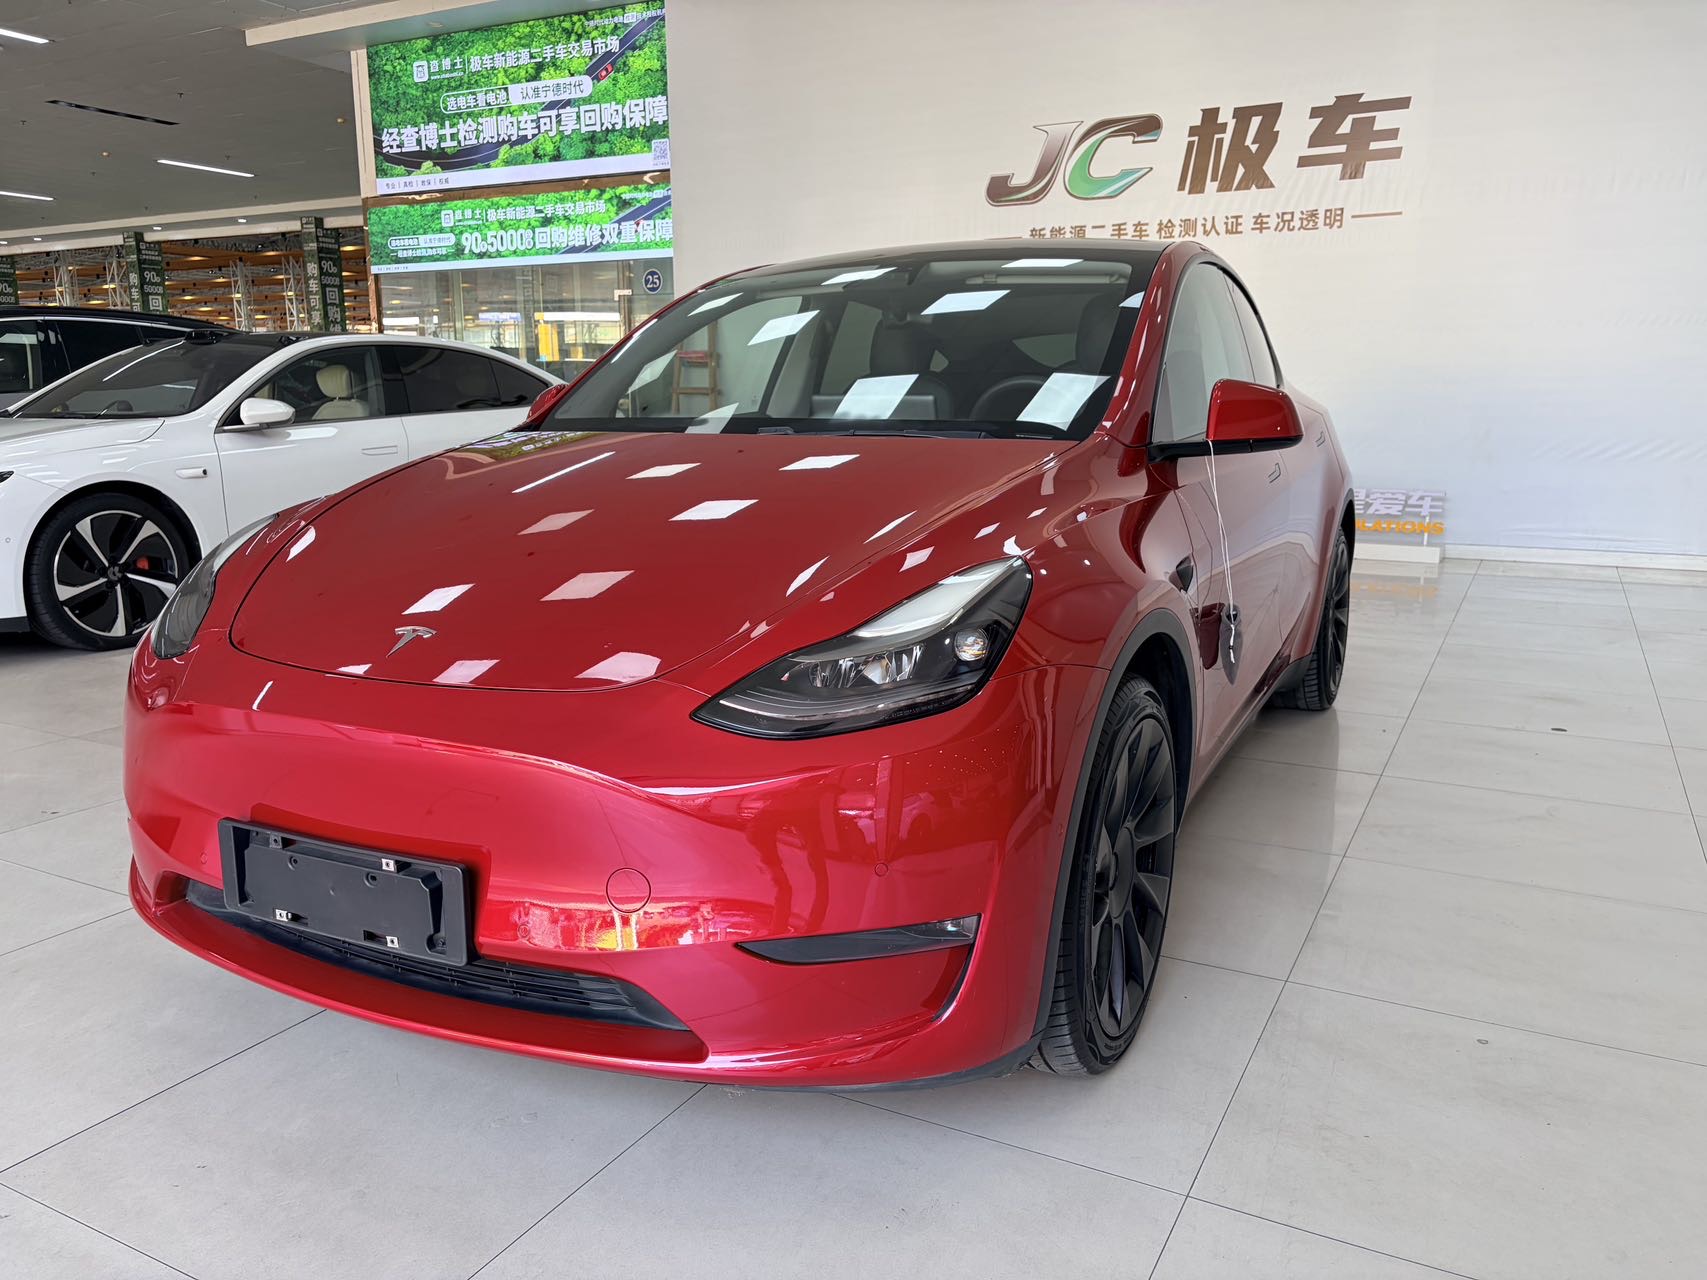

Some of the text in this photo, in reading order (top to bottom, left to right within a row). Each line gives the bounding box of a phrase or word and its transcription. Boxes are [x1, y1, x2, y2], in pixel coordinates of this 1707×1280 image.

[470, 36, 620, 72] 极车新能源二手车交易市场
[447, 80, 584, 111] 选电车看电池 认准宁德时代
[382, 95, 668, 154] 经查博士检测购车可享回购保障
[985, 113, 1163, 207] JC
[1177, 92, 1413, 196] 极车
[486, 199, 606, 222] 极车新能源二手车交易市场
[1156, 213, 1244, 239] 检测认证
[1251, 206, 1345, 234] 车况透明
[143, 270, 161, 283] 90
[320, 259, 338, 274] 90
[645, 274, 660, 288] 25
